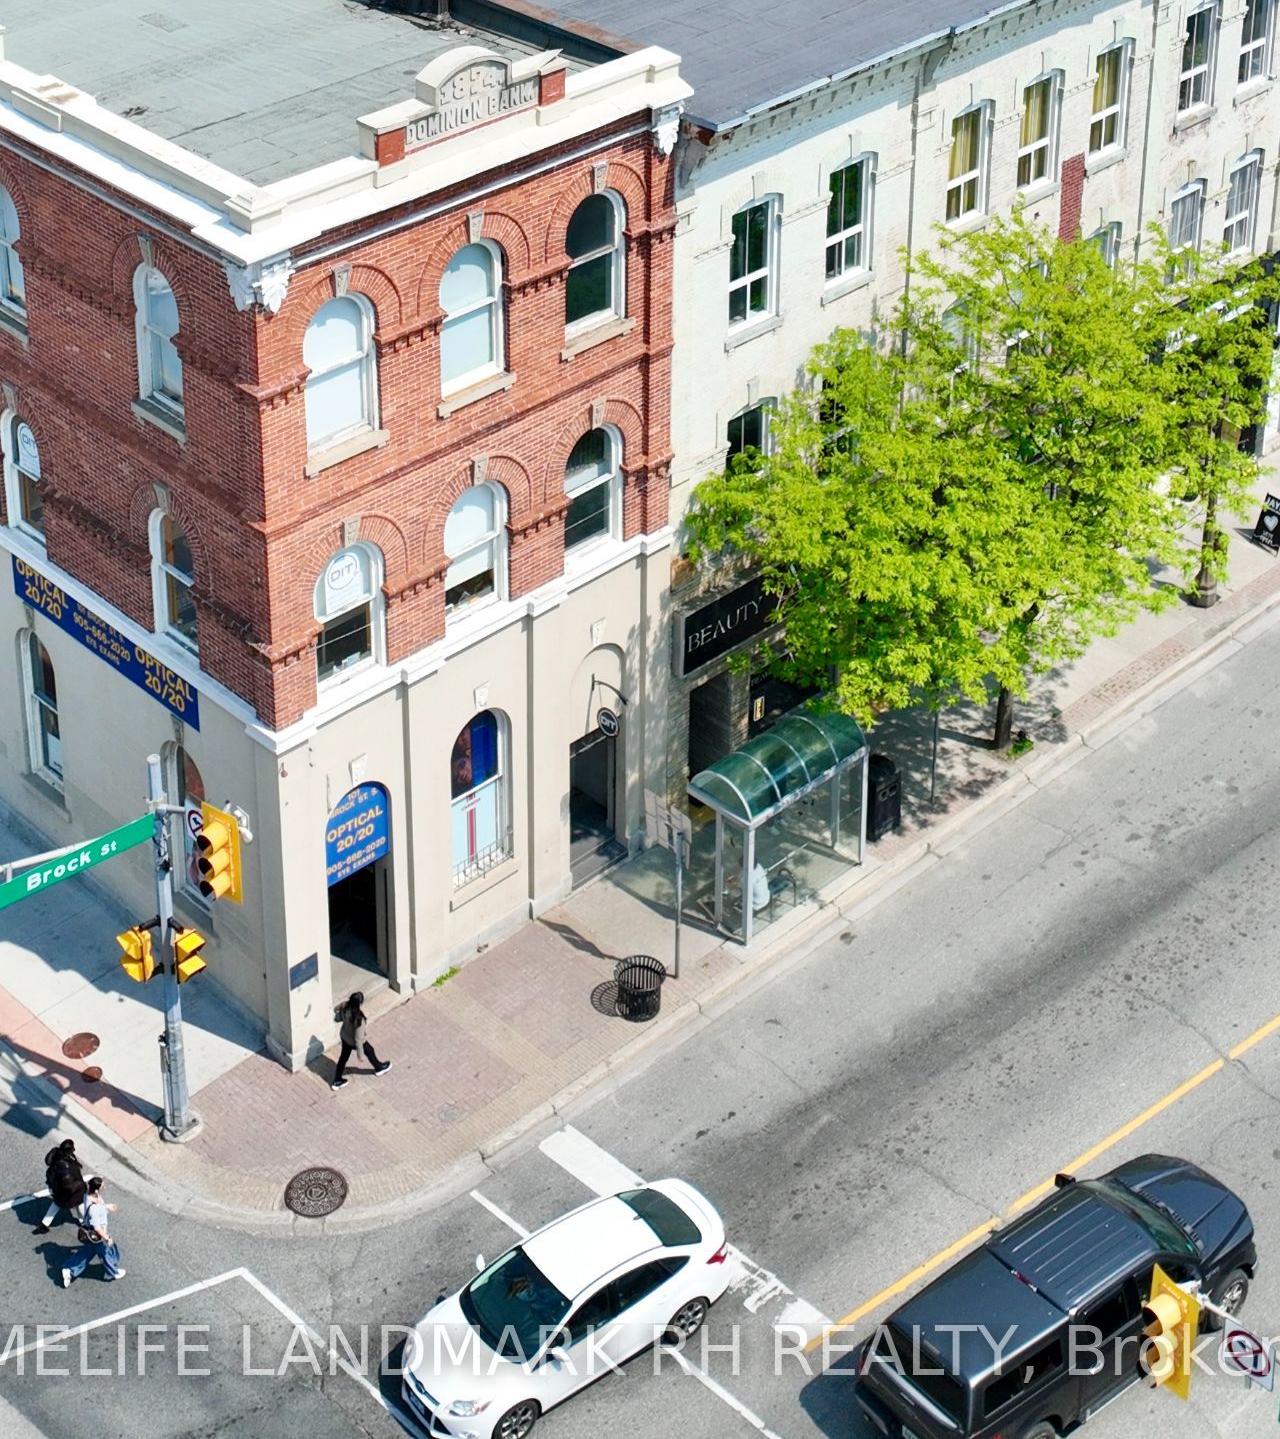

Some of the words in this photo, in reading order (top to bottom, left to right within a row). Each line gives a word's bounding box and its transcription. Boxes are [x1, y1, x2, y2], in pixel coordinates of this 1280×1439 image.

[405, 99, 483, 145] DOMINION
[22, 432, 38, 449] DIT
[15, 558, 69, 609] OPTICAL
[331, 563, 354, 582] DIT
[25, 582, 62, 620] 20/20
[73, 612, 131, 662] 905-666-2020
[687, 595, 764, 654] BEAUTY
[86, 635, 98, 649] EYE
[99, 644, 120, 665] EXAMS
[134, 645, 193, 702] OPTICAL
[144, 670, 186, 713] 20/20
[600, 714, 617, 731] DIT
[327, 805, 384, 842] OPTICAL
[337, 823, 375, 853] 20/20
[26, 848, 92, 892] Brock
[337, 866, 351, 879] EYE
[353, 851, 376, 869] EXAMS
